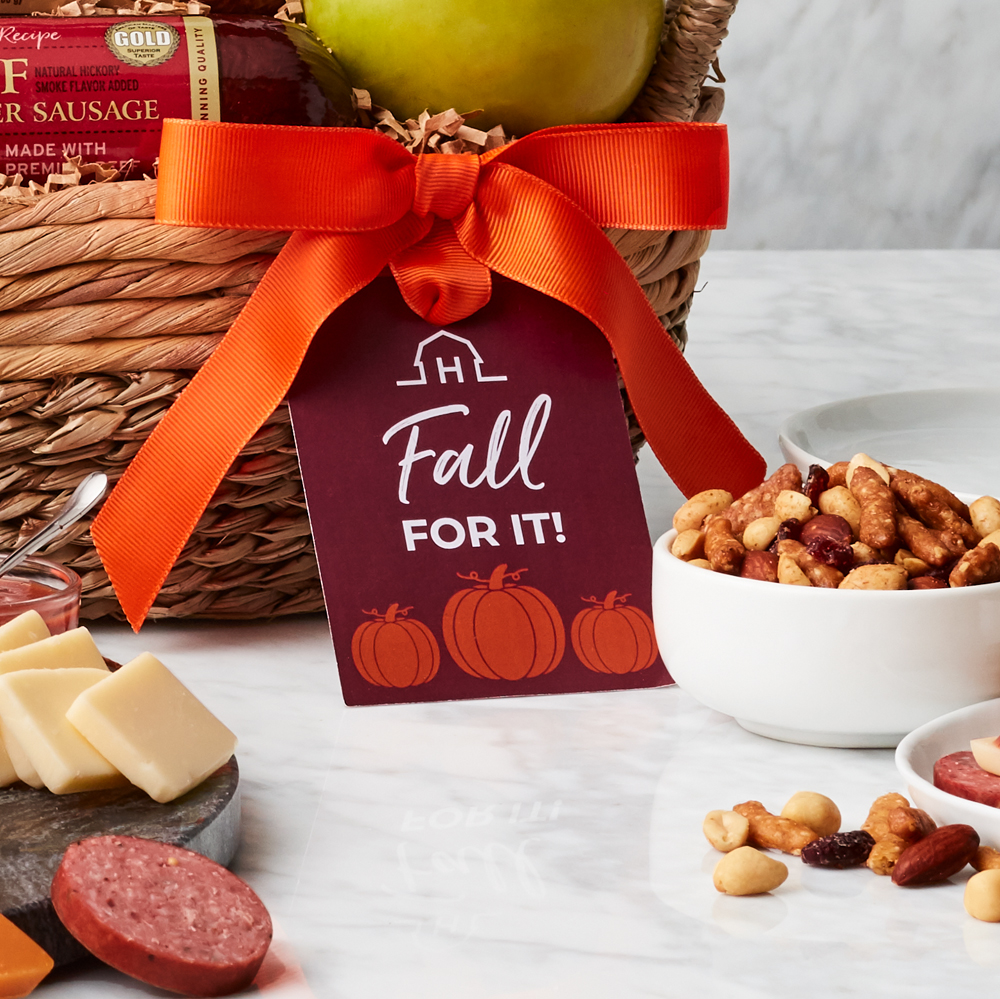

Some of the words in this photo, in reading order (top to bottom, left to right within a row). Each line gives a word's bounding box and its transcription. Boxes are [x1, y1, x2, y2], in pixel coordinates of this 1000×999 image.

[0, 27, 62, 50] Recipe
[114, 31, 171, 47] GOLD
[194, 28, 207, 72] QUALITY
[34, 66, 79, 78] NATURAL
[80, 65, 120, 77] HICKORY
[35, 81, 68, 93] SMOKE
[70, 80, 107, 93] FLAVOR
[108, 79, 139, 92] ADDED
[33, 99, 160, 123] SAUSAGE
[6, 143, 56, 158] MADE
[62, 142, 106, 156] WITH
[6, 162, 60, 175] PREMI
[436, 356, 465, 384] H
[382, 393, 552, 505] Fall
[402, 516, 500, 552] FOR
[510, 511, 567, 546] IT!
